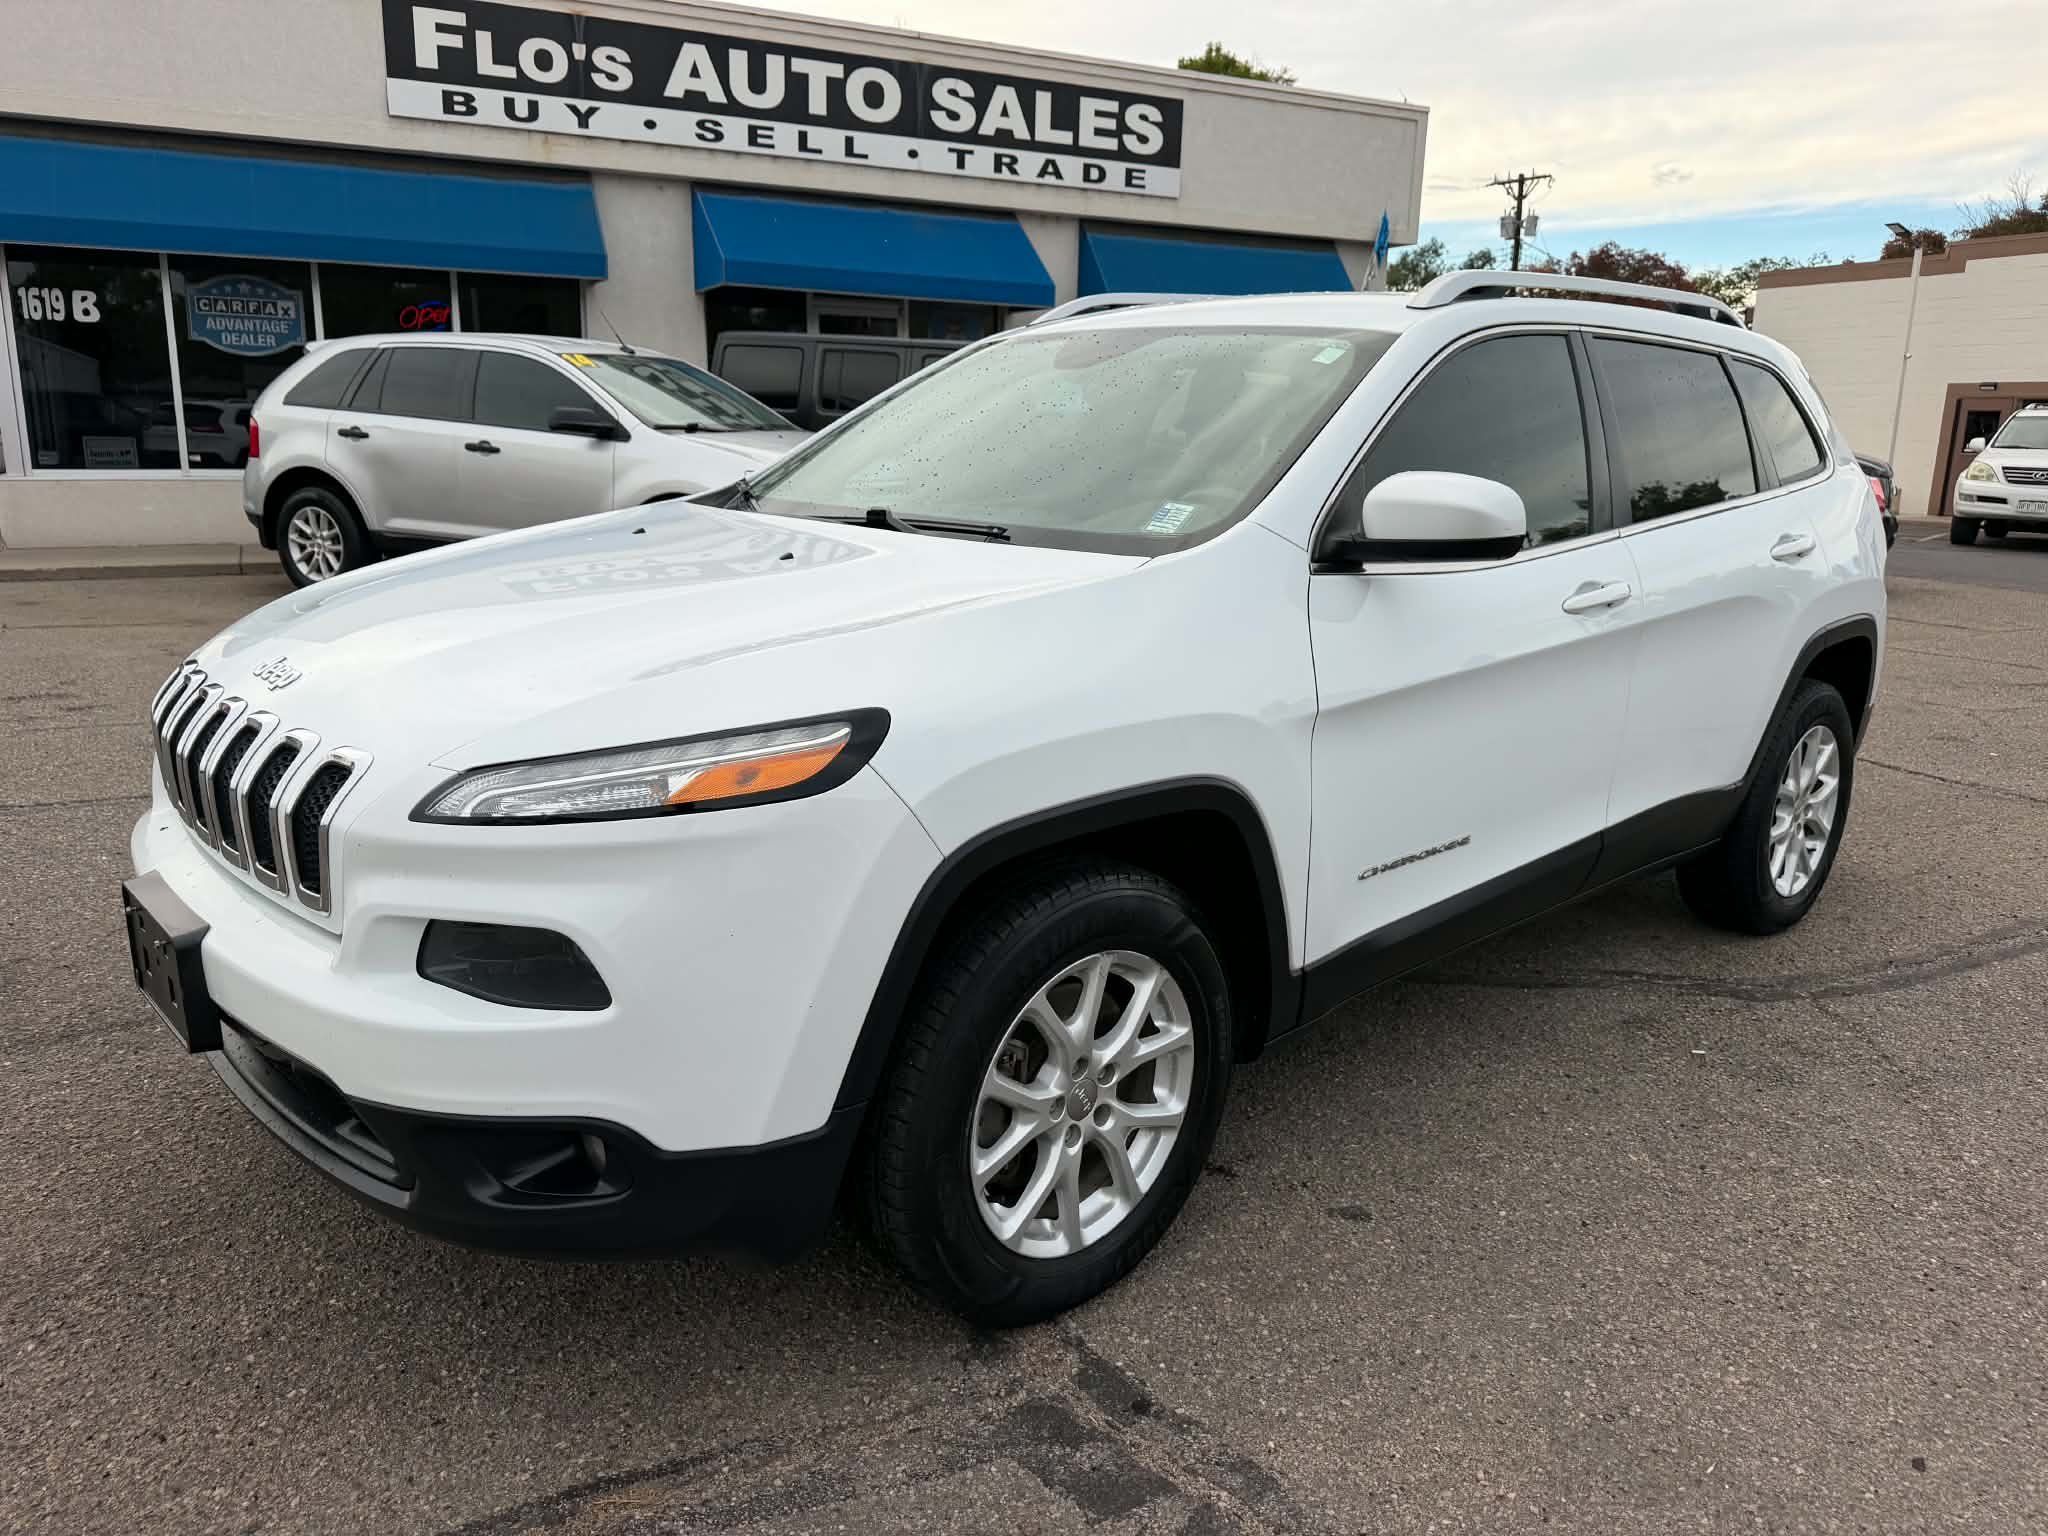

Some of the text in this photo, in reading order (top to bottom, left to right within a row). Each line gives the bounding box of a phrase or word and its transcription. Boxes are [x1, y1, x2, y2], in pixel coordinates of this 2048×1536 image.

[412, 5, 1165, 156] FLO'S AUTO SALES
[441, 88, 1147, 189] BUY SELL TRADE
[17, 286, 101, 323] 1619 B
[197, 298, 296, 318] CARFAX
[206, 317, 289, 335] ADVANTAGE
[221, 332, 277, 347] DEALER
